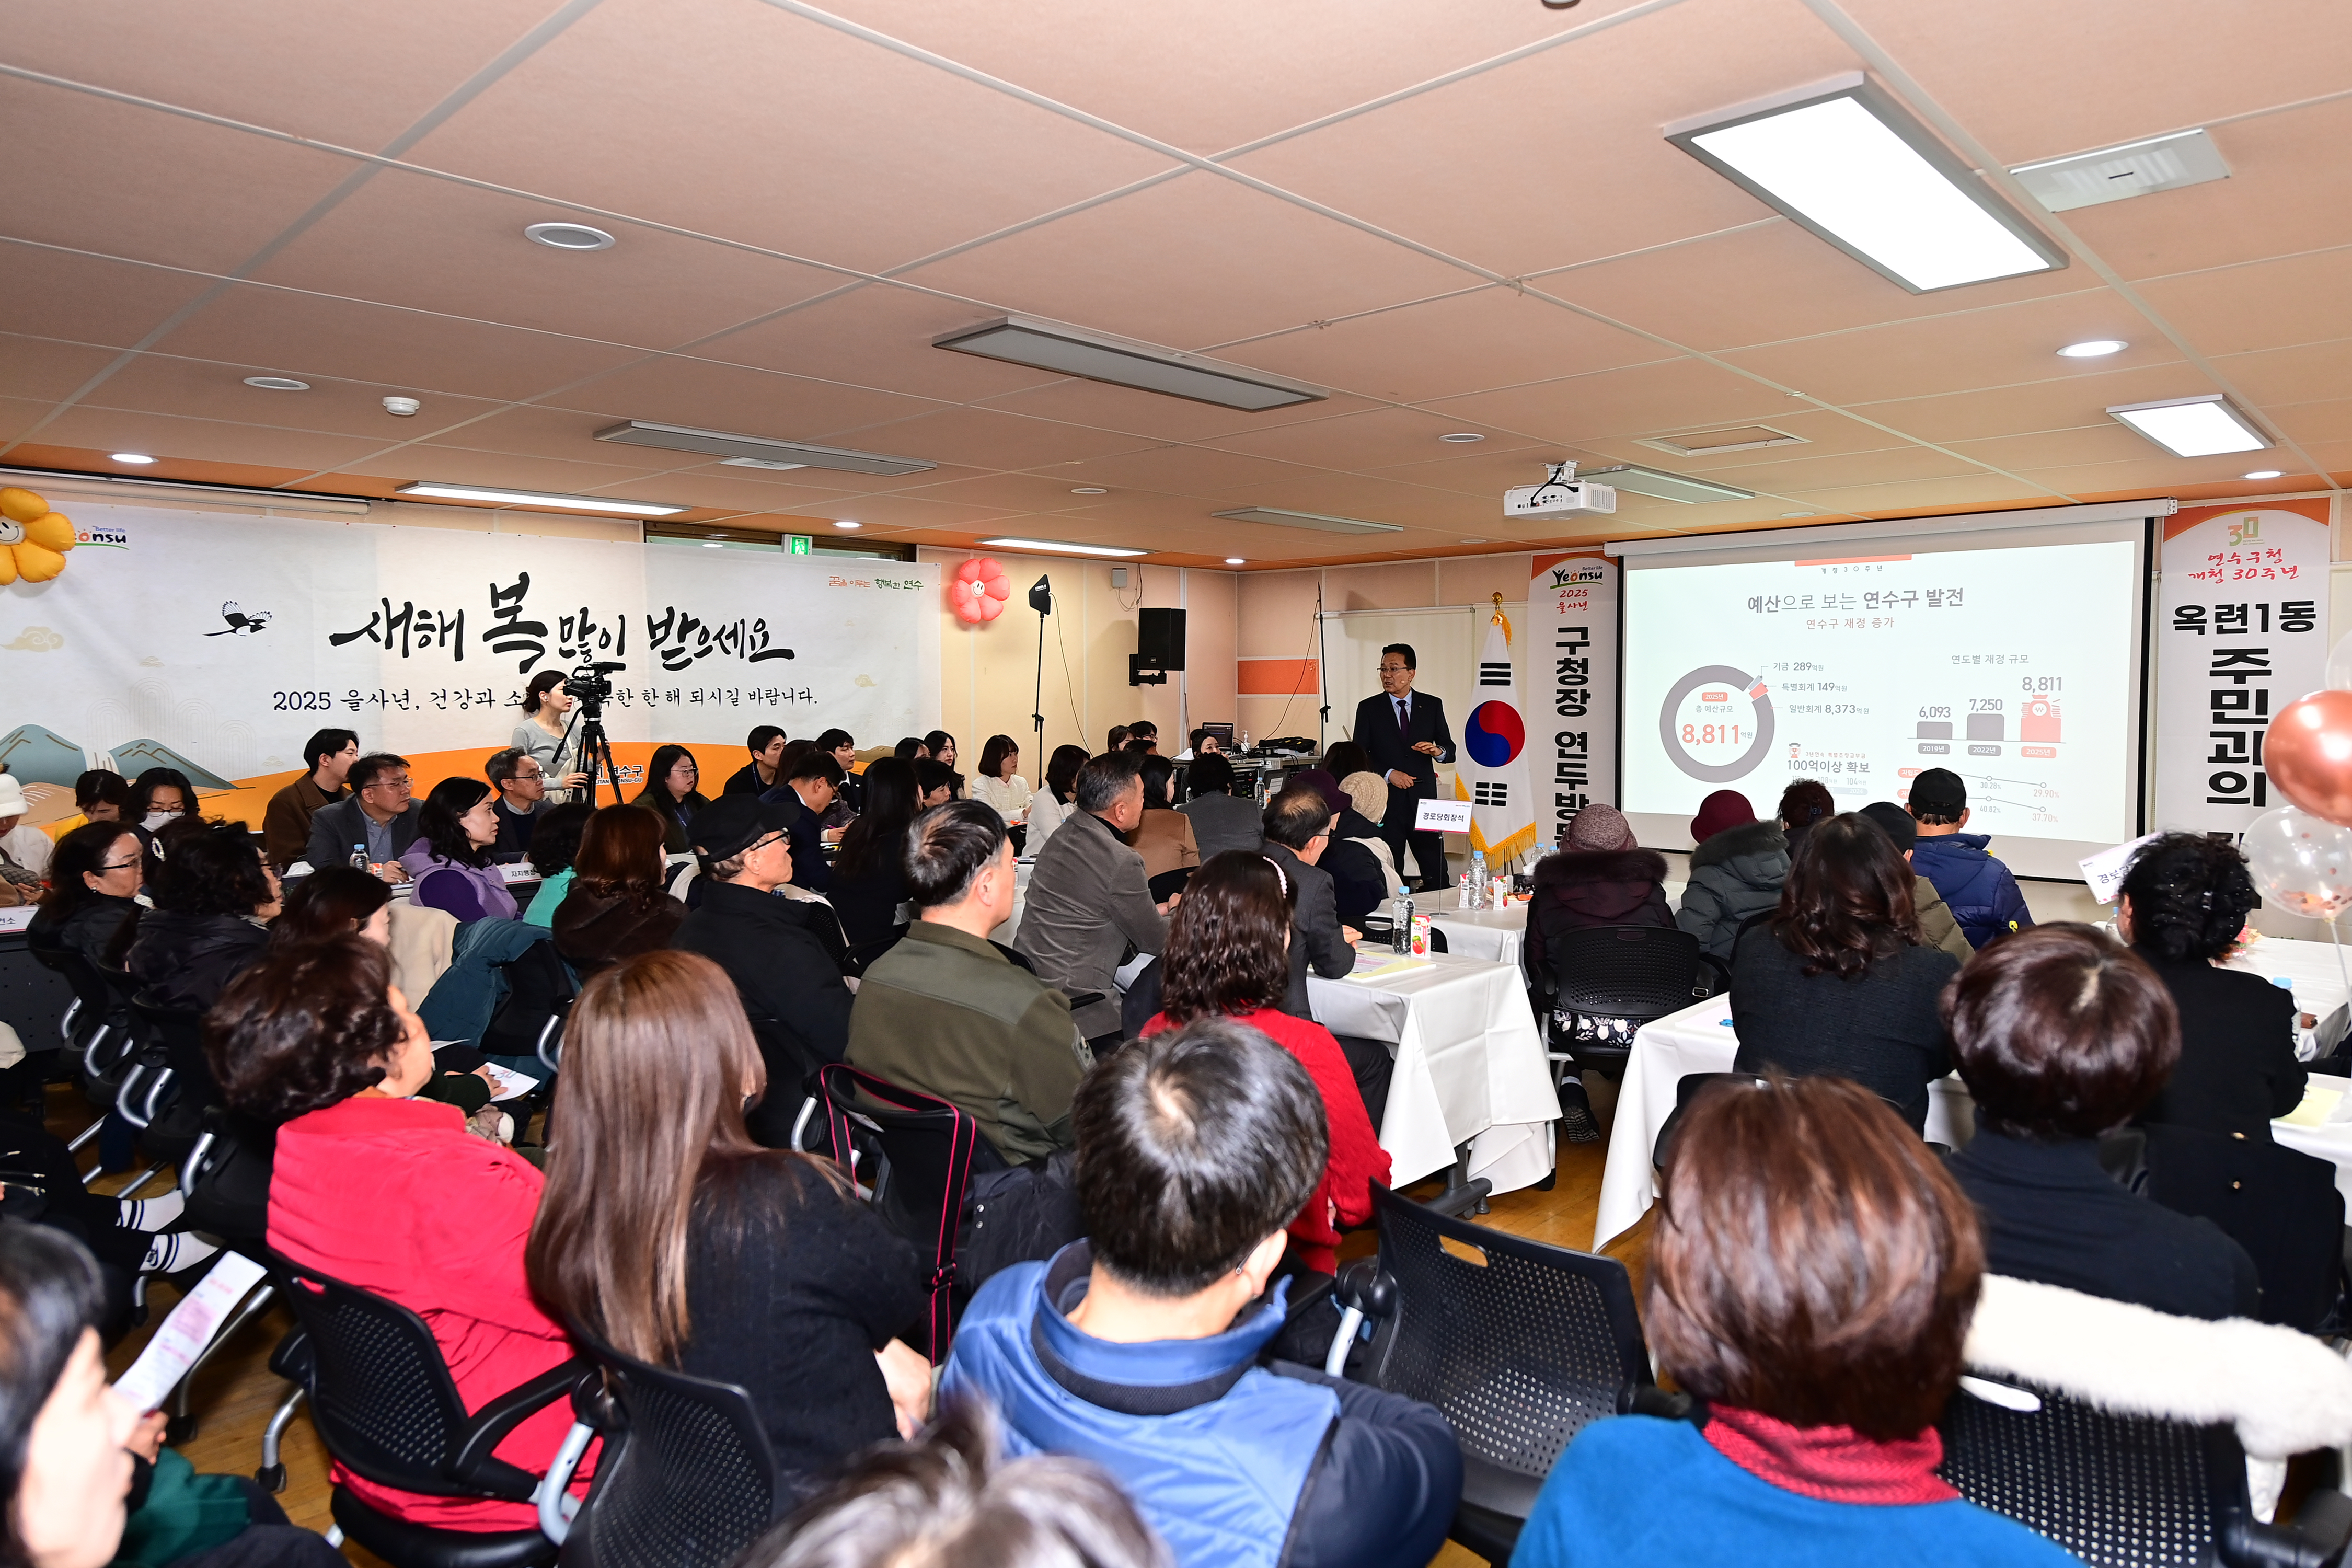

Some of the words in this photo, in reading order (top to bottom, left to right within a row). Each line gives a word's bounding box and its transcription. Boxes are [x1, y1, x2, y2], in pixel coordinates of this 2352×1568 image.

[75, 532, 126, 543] onsu
[2228, 516, 2259, 546] 30
[2207, 548, 2283, 566] 연수구청
[1552, 569, 1603, 586] Yeonsu
[2188, 568, 2224, 584] 개청
[2232, 565, 2299, 580] 30주년
[829, 576, 848, 587] 꿈을
[849, 579, 871, 588] 이루는
[874, 578, 901, 590] 행복한
[903, 579, 924, 591] 연수
[1559, 589, 1588, 598] 2025
[1747, 594, 1816, 614] 예산으로
[1821, 592, 1857, 609] 보는
[1863, 590, 1919, 610] 연수구
[1926, 587, 1964, 608] 발전
[1556, 601, 1588, 614] 을사년
[329, 597, 465, 662] 새해
[482, 572, 548, 674] 복
[559, 606, 626, 663] 많이
[647, 606, 795, 671] 받으세요
[1806, 618, 1839, 630] 연수구
[1844, 617, 1866, 629] 재정
[1871, 617, 1895, 628] 증가
[2173, 601, 2317, 636] 옥련1동
[1773, 662, 1790, 671] 기금
[1951, 654, 1981, 665] 연도별
[1985, 654, 2005, 664] 재정
[2008, 654, 2030, 664] 규모
[1554, 627, 1591, 717] 구청장
[1781, 682, 1815, 692] 특별회계
[2022, 676, 2062, 694] 8,811
[273, 691, 332, 712] 2025
[340, 688, 420, 711] 을사년,
[428, 688, 496, 711] 건강과
[602, 688, 635, 708] 한
[641, 688, 660, 708] 한
[665, 688, 681, 708] 해
[689, 687, 740, 707] 되시길
[748, 687, 818, 707] 바랍니다.
[1969, 699, 2003, 712] 7,250
[1695, 704, 1703, 713] 총
[1704, 705, 1734, 713] 예산규모
[1789, 704, 1822, 714] 일반회계
[1919, 706, 1951, 720] 6,093
[2207, 648, 2272, 807] 주민과의
[2026, 748, 2050, 756] 2025년
[1787, 760, 1843, 773] 100억이상
[1846, 761, 1871, 774] 확보
[1554, 731, 1590, 850] 연두방
[2033, 789, 2060, 798] 29.90%
[1423, 812, 1465, 822] 경로당회장석
[2032, 813, 2059, 823] 37.70%
